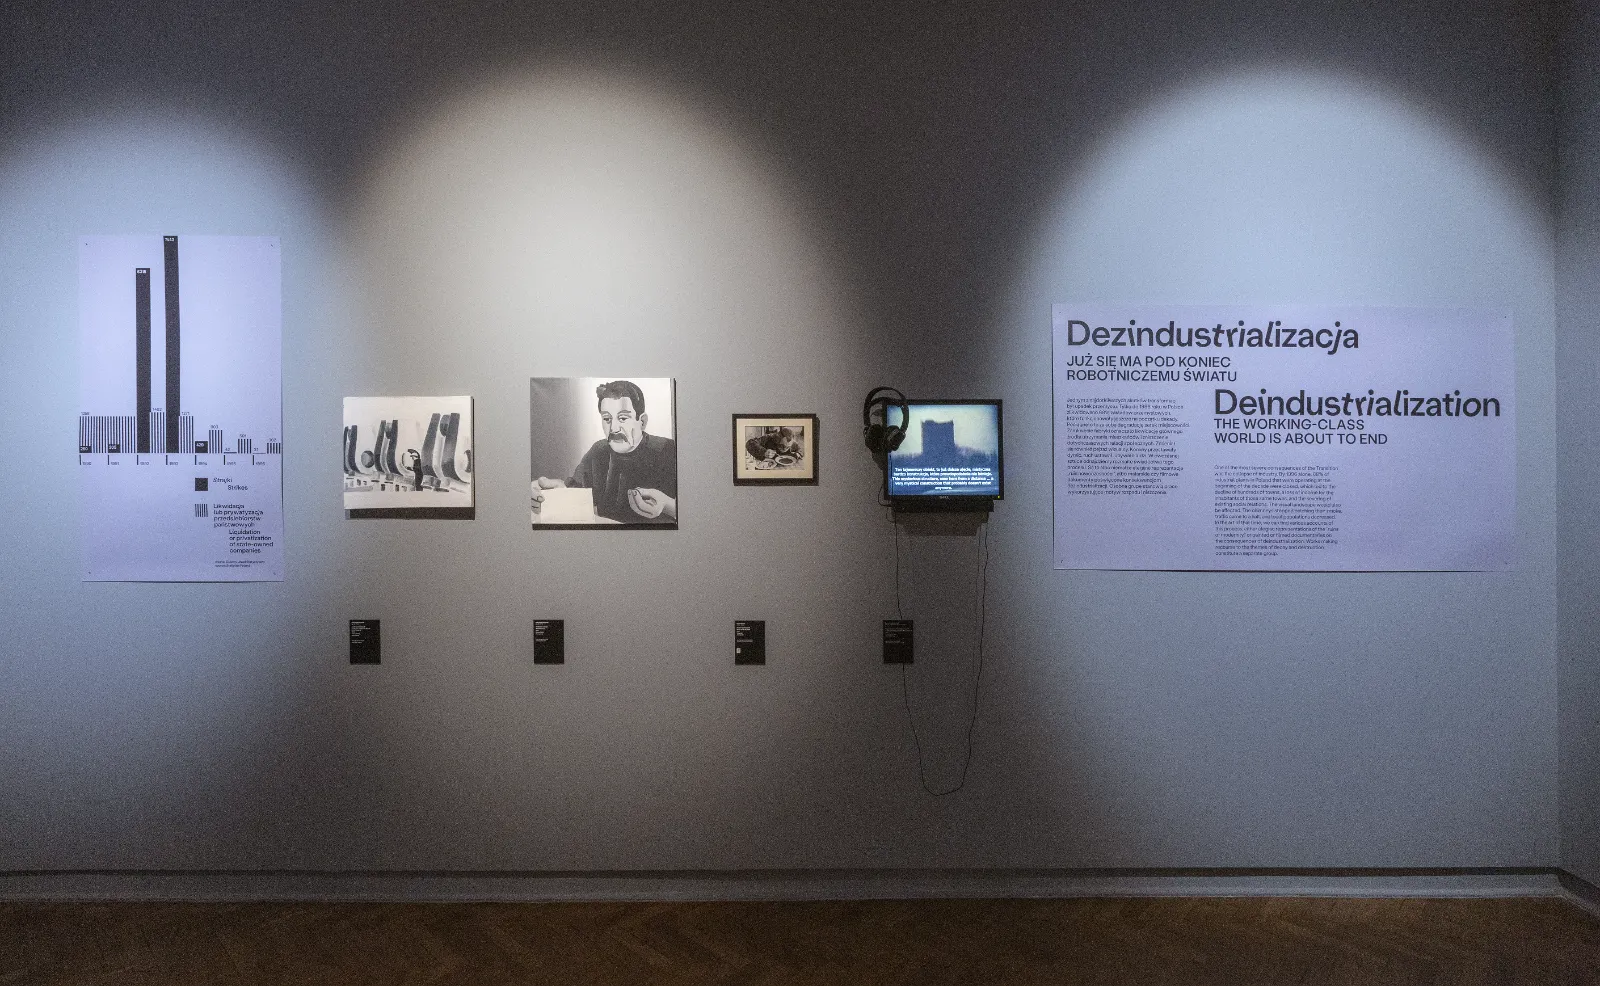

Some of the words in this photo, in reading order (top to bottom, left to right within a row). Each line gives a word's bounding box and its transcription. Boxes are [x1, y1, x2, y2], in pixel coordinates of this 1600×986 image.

[1067, 319, 1359, 355] Dezindustrializacja
[1066, 353, 1093, 367] JUŻ
[1096, 356, 1116, 368] SIĘ
[1120, 357, 1142, 367] MA
[1145, 357, 1176, 368] POD
[1179, 357, 1231, 368] KONIEC
[1067, 370, 1180, 381] ROBOTNICZEMU
[1183, 368, 1237, 382] ŚWIATU
[1215, 389, 1500, 417] Deindustrialization
[1214, 419, 1240, 429] THE
[1244, 419, 1364, 430] WORKING-CLASS
[1214, 433, 1266, 443] WORLD
[1270, 433, 1282, 444] IS
[1285, 433, 1332, 444] ABOUT
[1338, 434, 1356, 444] TO
[1360, 434, 1388, 444] END
